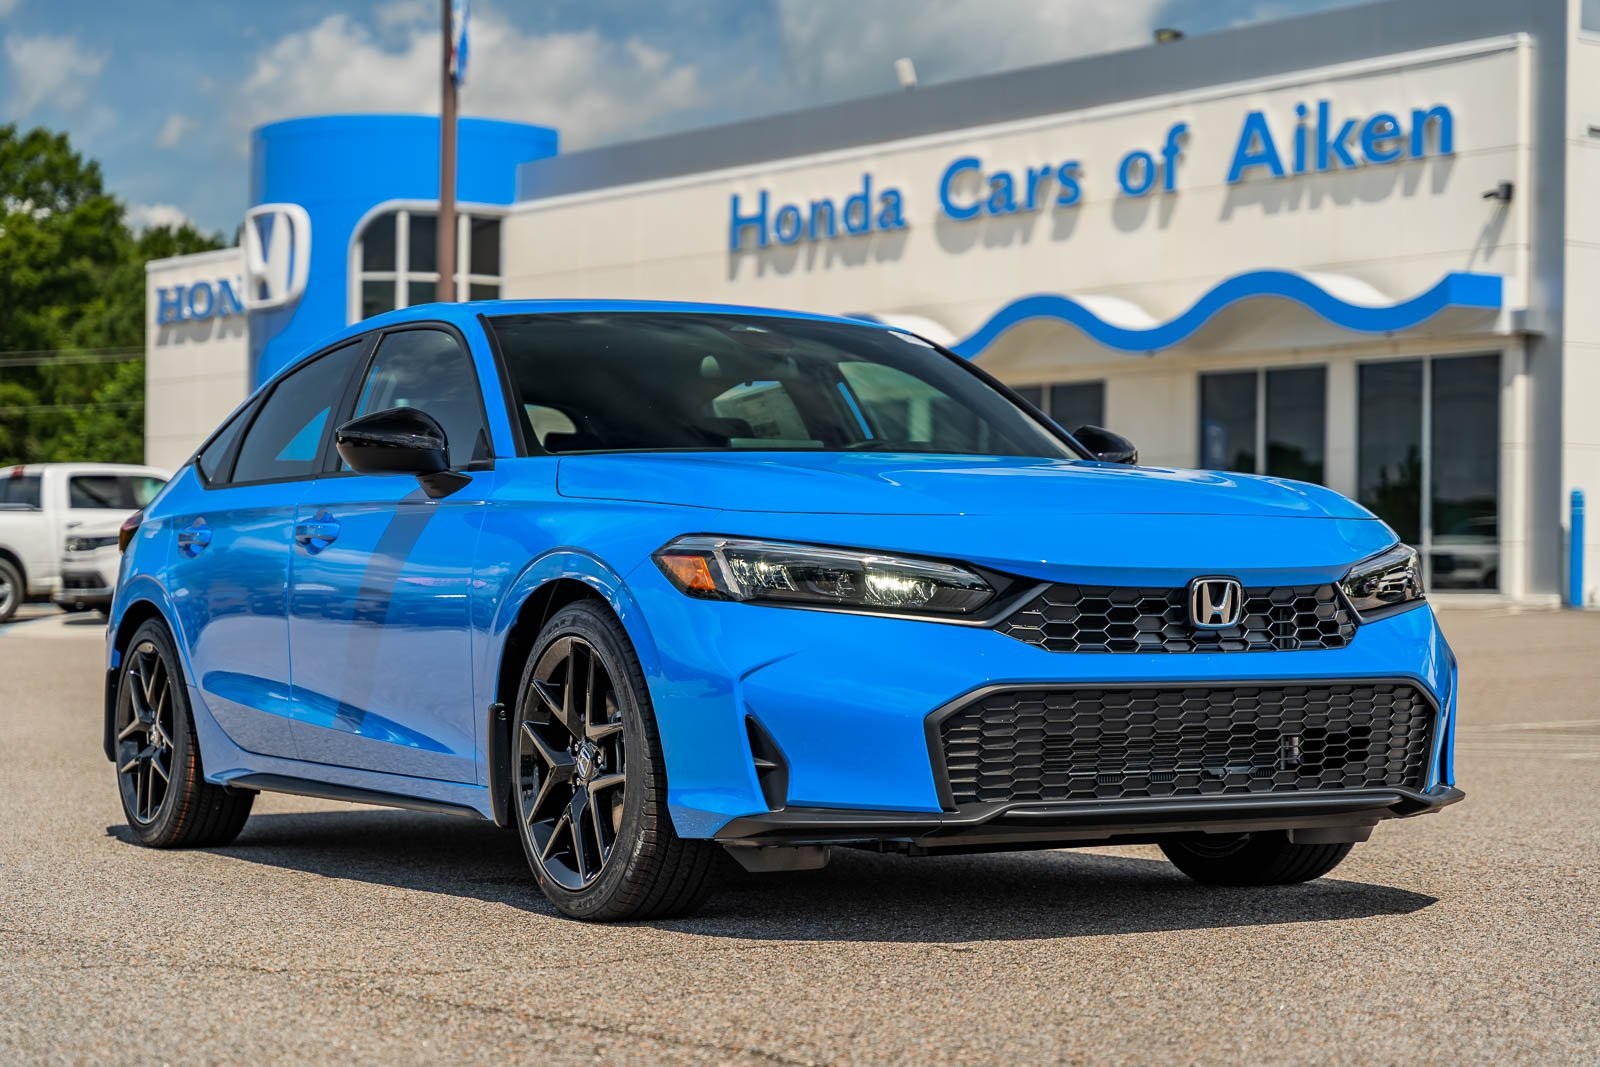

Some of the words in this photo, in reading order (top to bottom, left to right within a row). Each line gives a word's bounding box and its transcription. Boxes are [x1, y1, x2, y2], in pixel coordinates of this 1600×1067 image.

[729, 173, 906, 251] Honda
[938, 156, 1082, 221] Cars
[1117, 122, 1188, 196] of
[1226, 99, 1454, 184] Aiken
